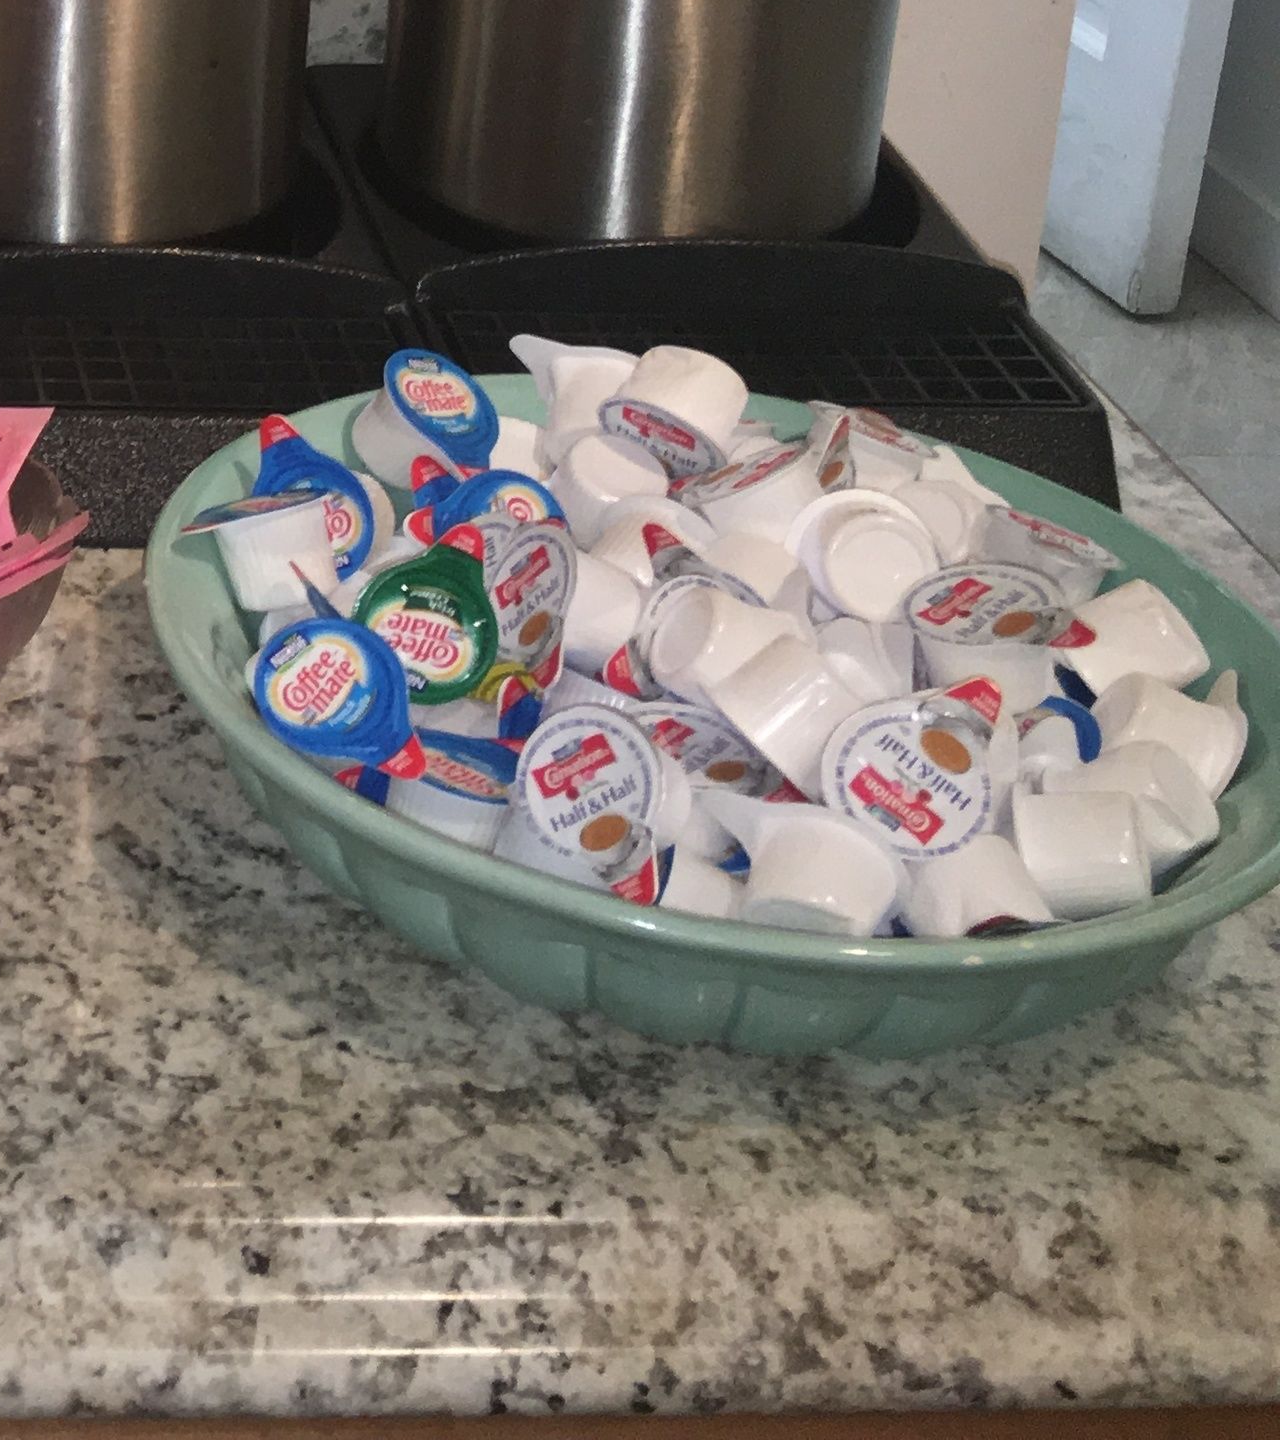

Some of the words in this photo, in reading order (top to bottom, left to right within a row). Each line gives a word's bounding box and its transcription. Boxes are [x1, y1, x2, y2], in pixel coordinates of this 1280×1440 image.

[387, 613, 449, 640] mate
[312, 660, 356, 714] mate
[549, 800, 588, 832] Half
[601, 774, 638, 806] Half
